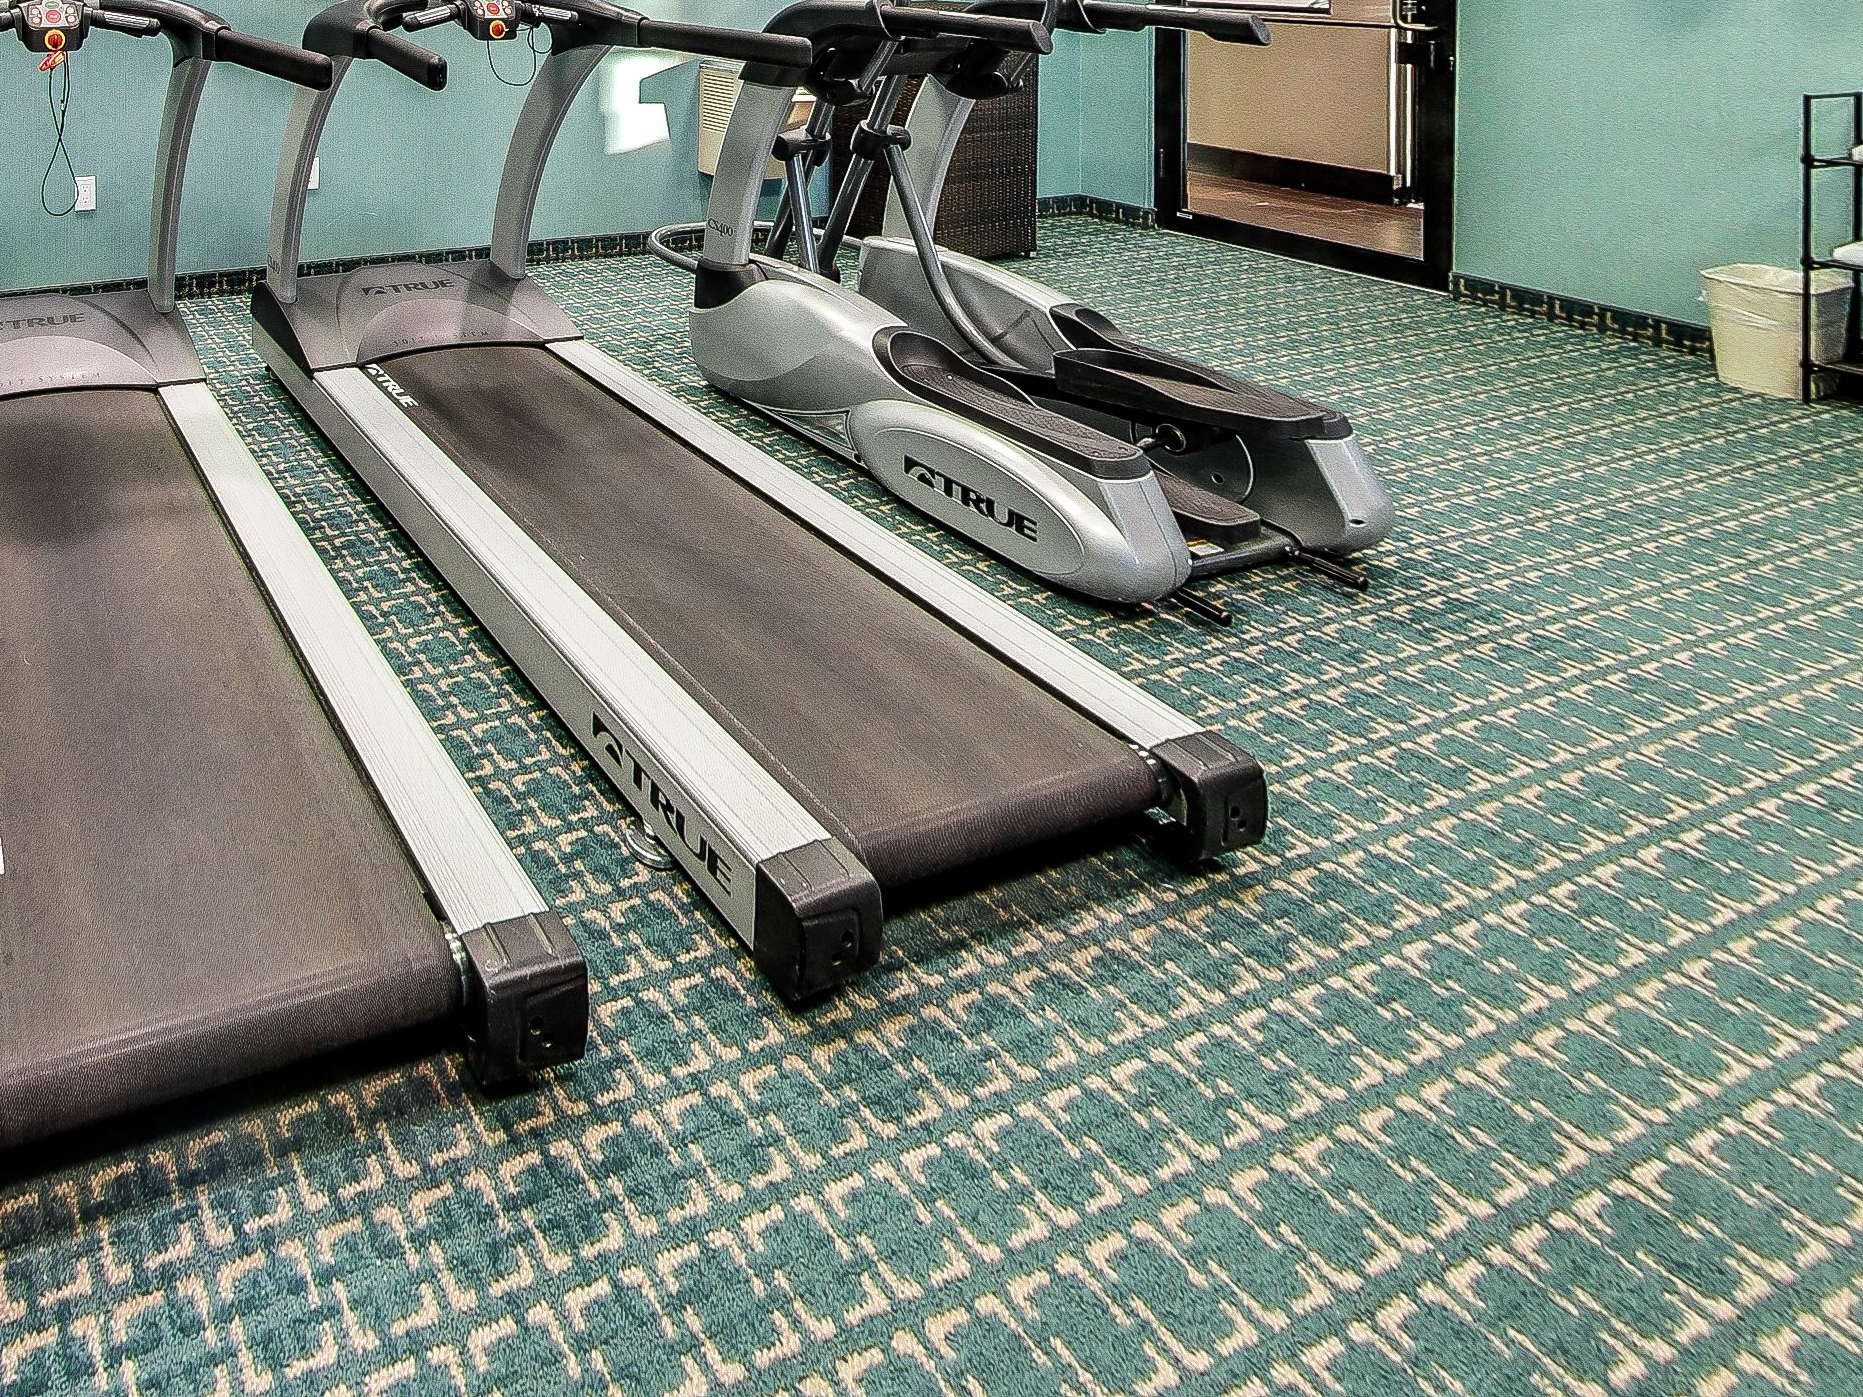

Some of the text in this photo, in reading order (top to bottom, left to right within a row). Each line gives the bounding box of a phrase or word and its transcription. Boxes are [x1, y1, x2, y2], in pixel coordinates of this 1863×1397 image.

[387, 278, 455, 294] TRUE
[5, 312, 86, 330] TRUE
[376, 374, 420, 408] TRUE
[935, 470, 1038, 542] TRUE
[624, 747, 734, 898] TRUE
